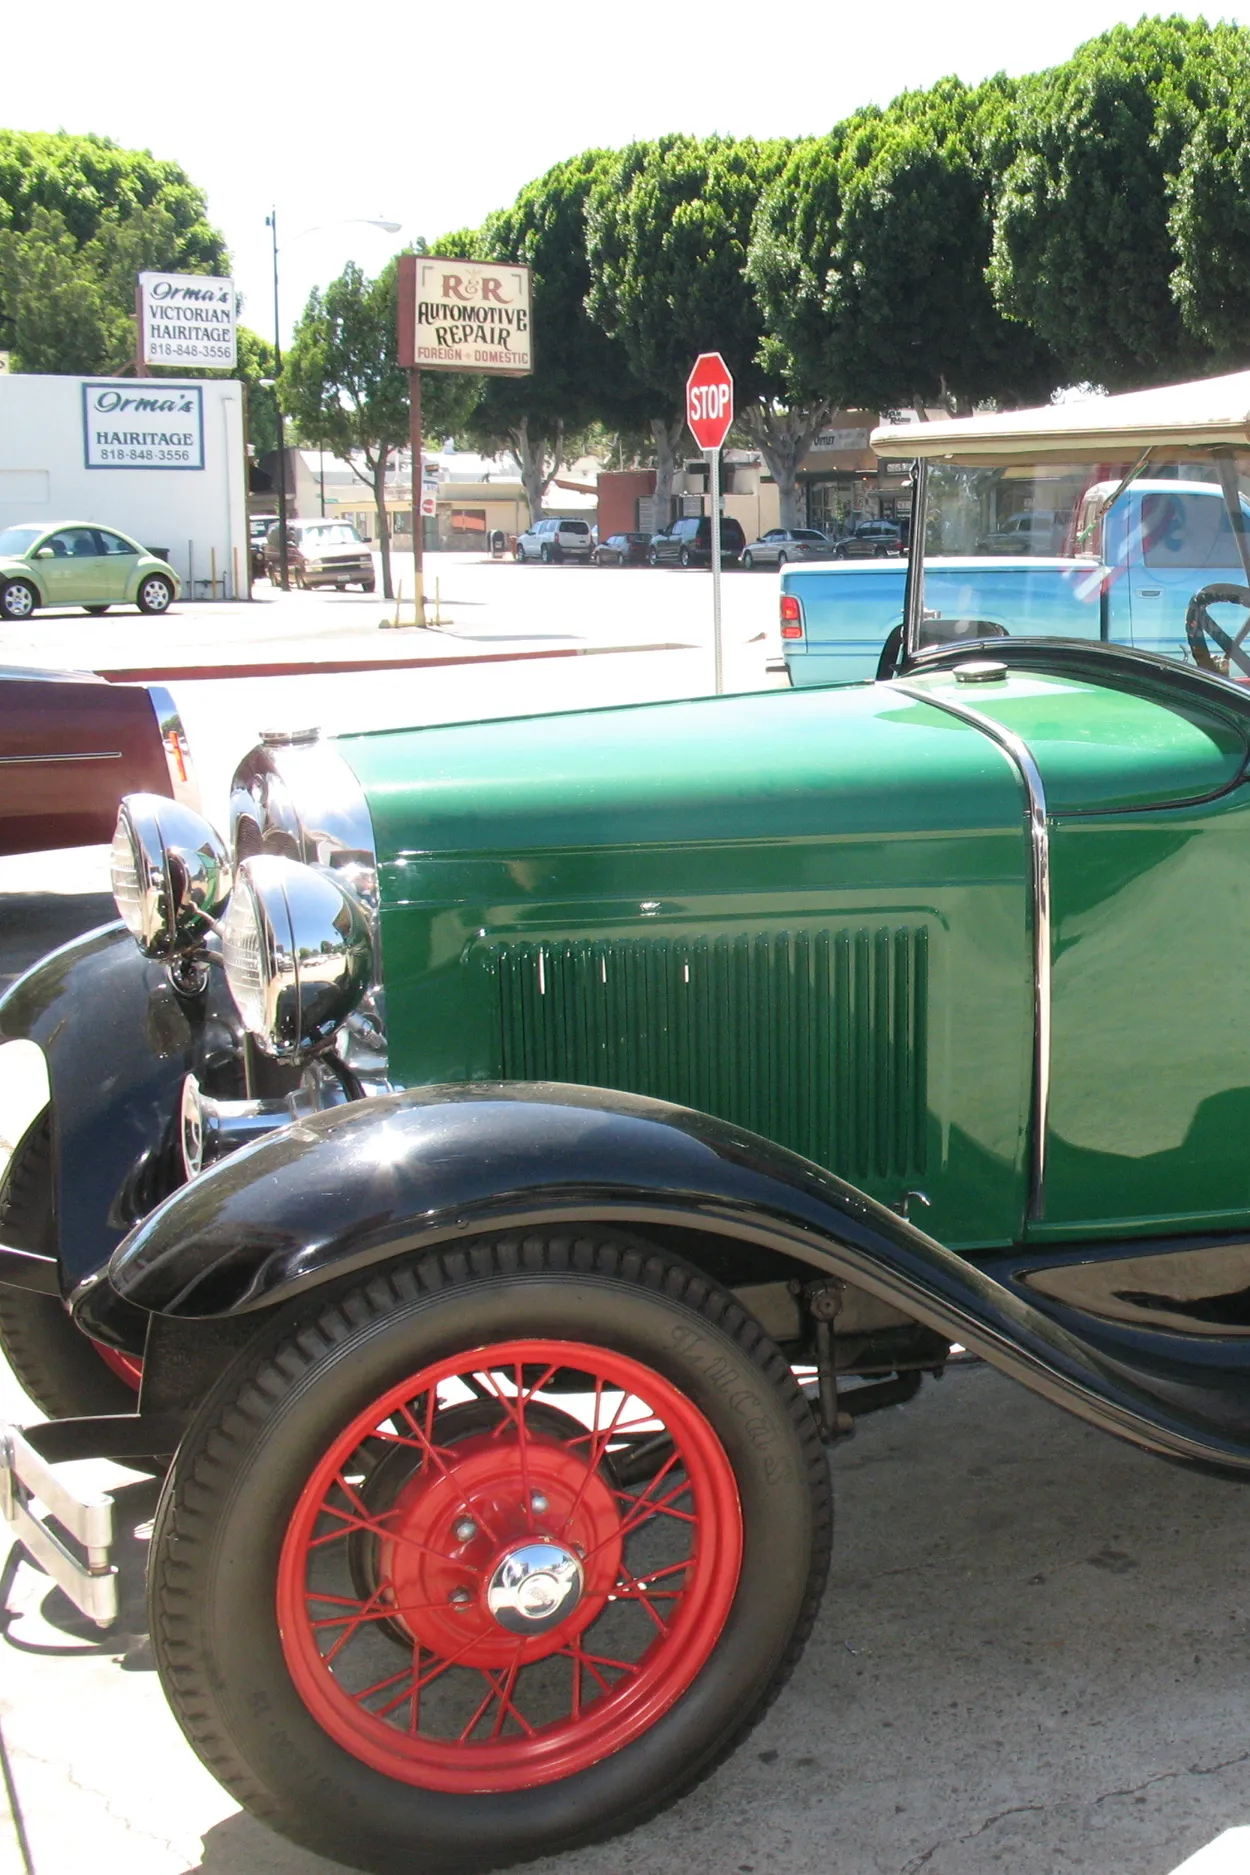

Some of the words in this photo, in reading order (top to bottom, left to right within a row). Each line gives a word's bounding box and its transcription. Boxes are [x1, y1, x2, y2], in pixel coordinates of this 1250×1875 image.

[149, 304, 231, 323] VICTORIAN
[417, 301, 528, 332] AUTOMOTIVE
[150, 324, 231, 342] HAIRITAGE
[435, 324, 512, 352] REPAIR
[150, 343, 231, 358] 818-848-3556
[417, 346, 462, 361] FOREIGN
[474, 350, 529, 364] DOMESTIC
[690, 383, 730, 421] STOP
[96, 431, 194, 446] HAIRITAGE
